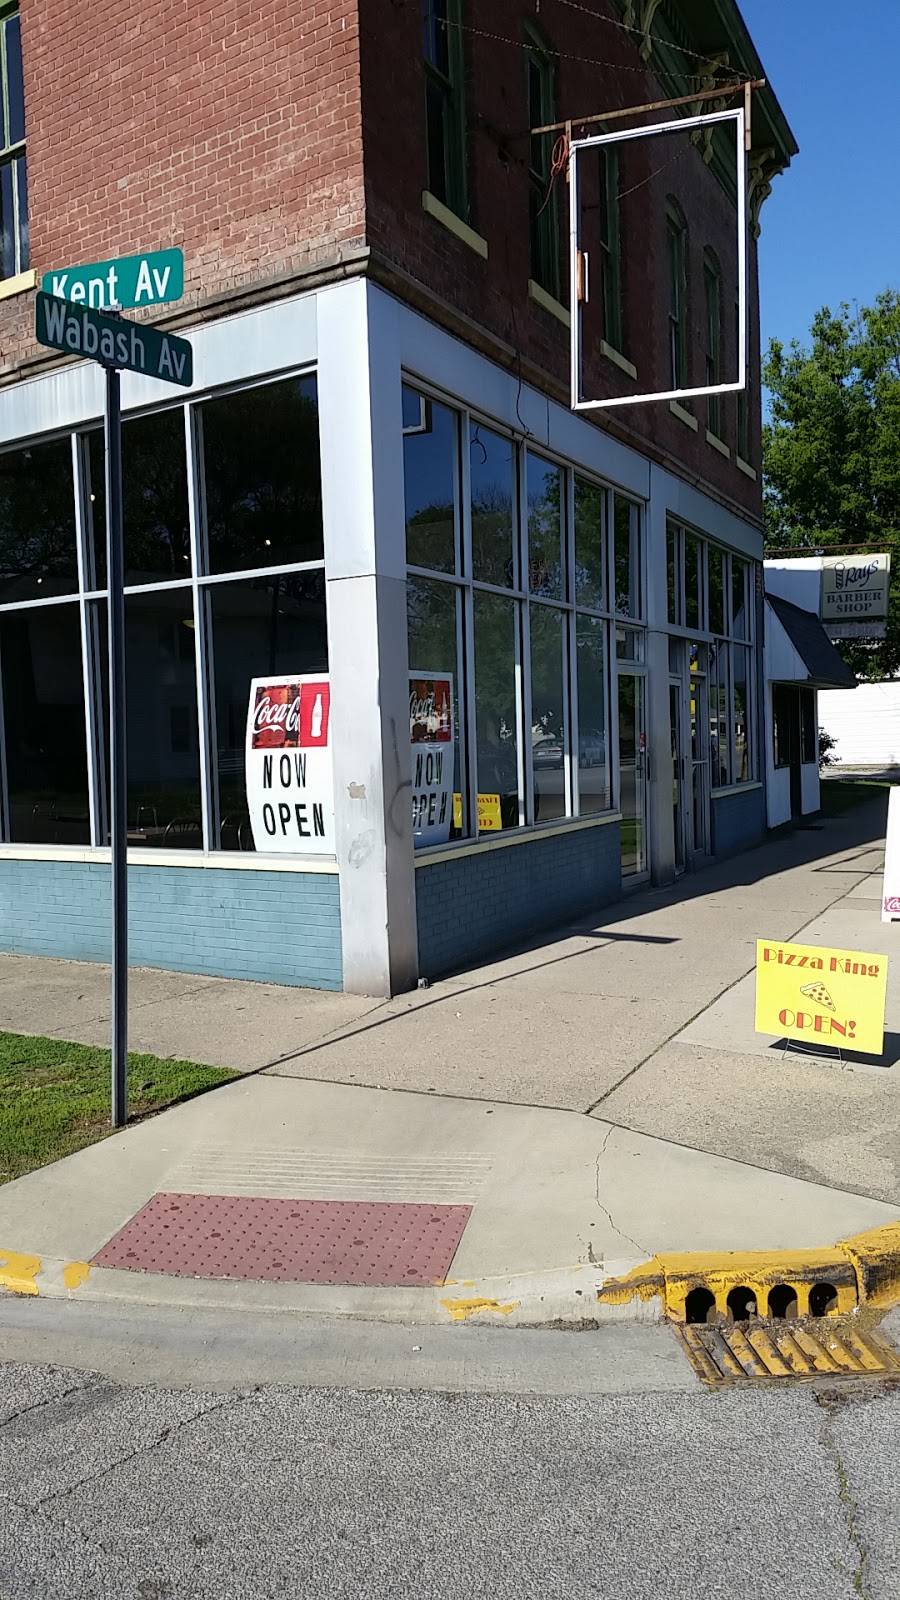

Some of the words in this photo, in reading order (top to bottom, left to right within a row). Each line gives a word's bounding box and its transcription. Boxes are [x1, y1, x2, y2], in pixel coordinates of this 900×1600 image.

[52, 266, 119, 311] Kent
[134, 260, 171, 302] Av
[44, 299, 145, 368] Wabash
[158, 338, 186, 379] Av
[826, 592, 881, 603] BARBER
[836, 602, 872, 613] SHOP
[263, 753, 307, 788] NOW
[415, 752, 443, 788] NOW
[263, 803, 326, 837] OPEN
[763, 948, 824, 970] Pizza
[829, 957, 880, 977] King
[778, 1008, 857, 1039] OPEN!
